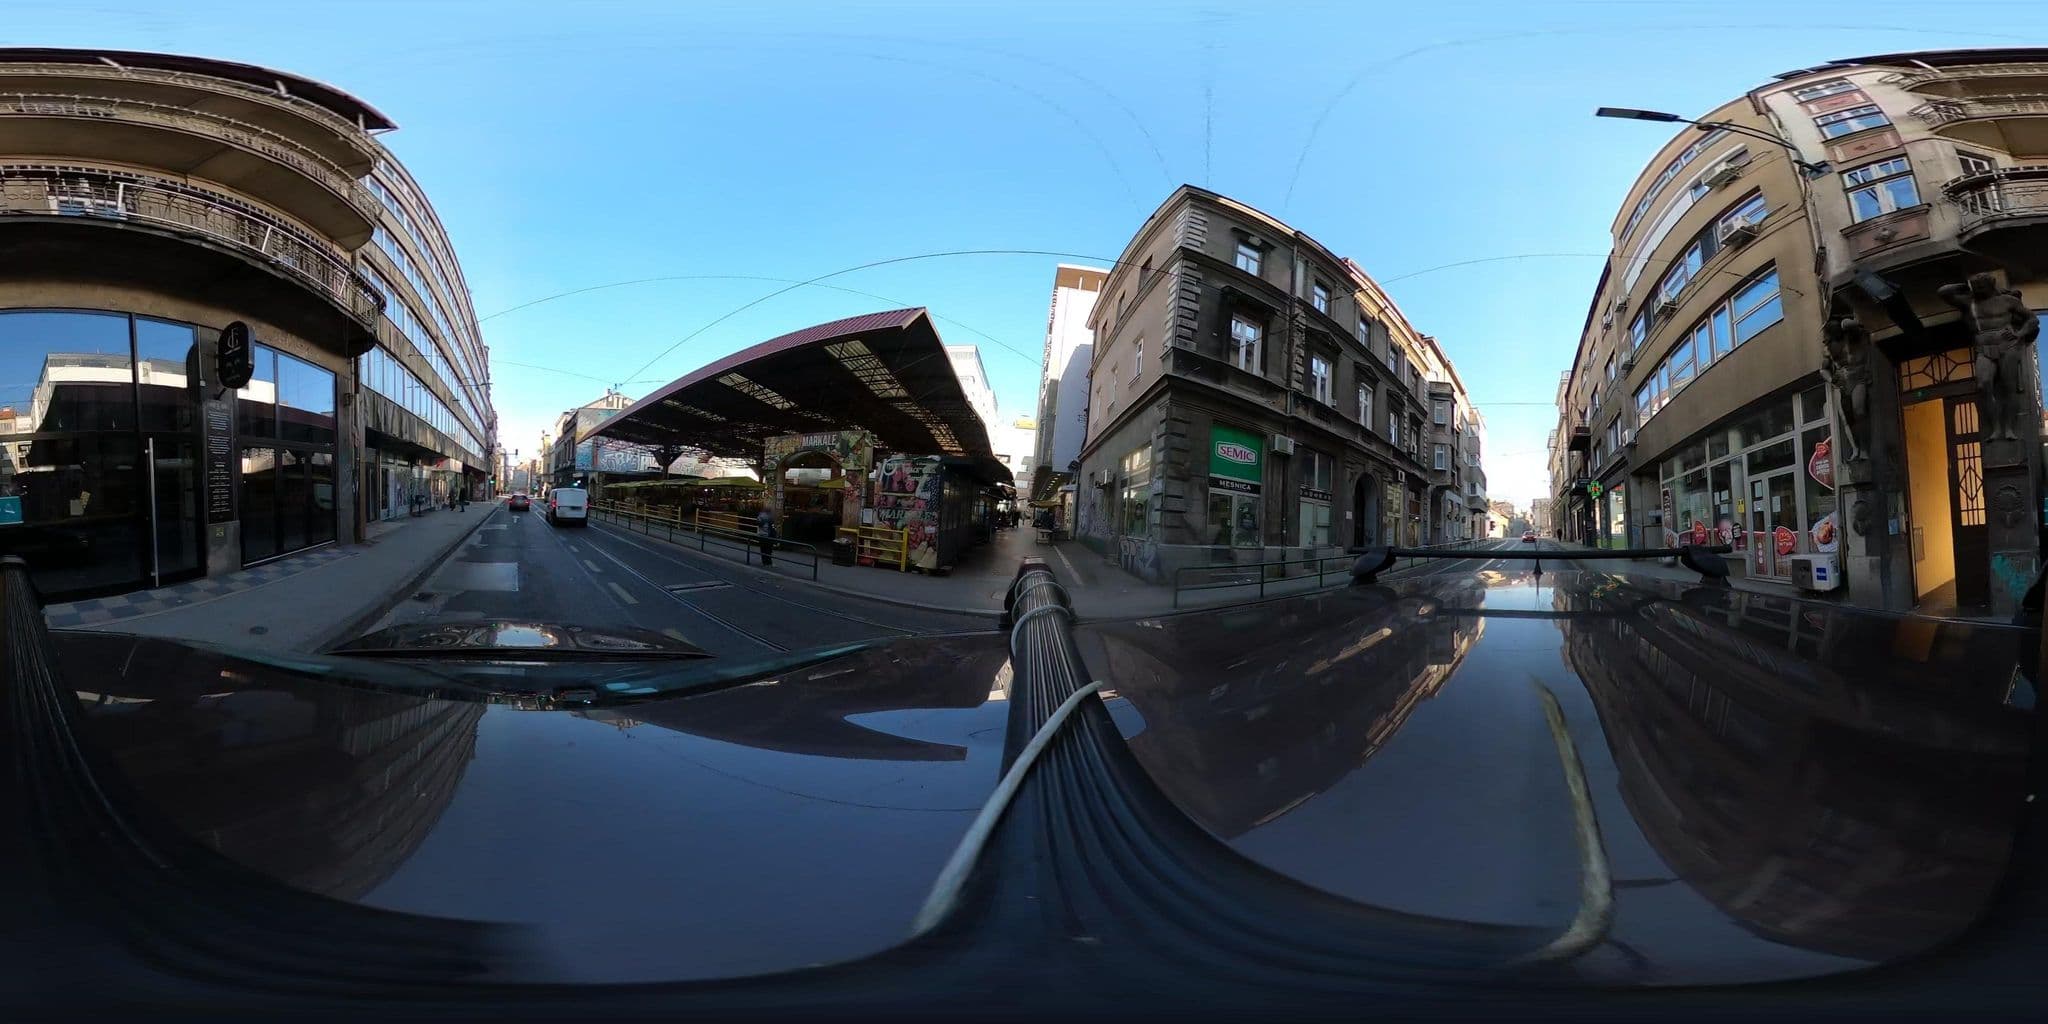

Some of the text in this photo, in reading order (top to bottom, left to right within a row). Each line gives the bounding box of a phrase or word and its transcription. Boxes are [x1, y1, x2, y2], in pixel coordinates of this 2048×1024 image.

[802, 433, 837, 447] MARKALE
[1220, 446, 1254, 461] SEMIC
[1219, 480, 1252, 490] MESNICA
